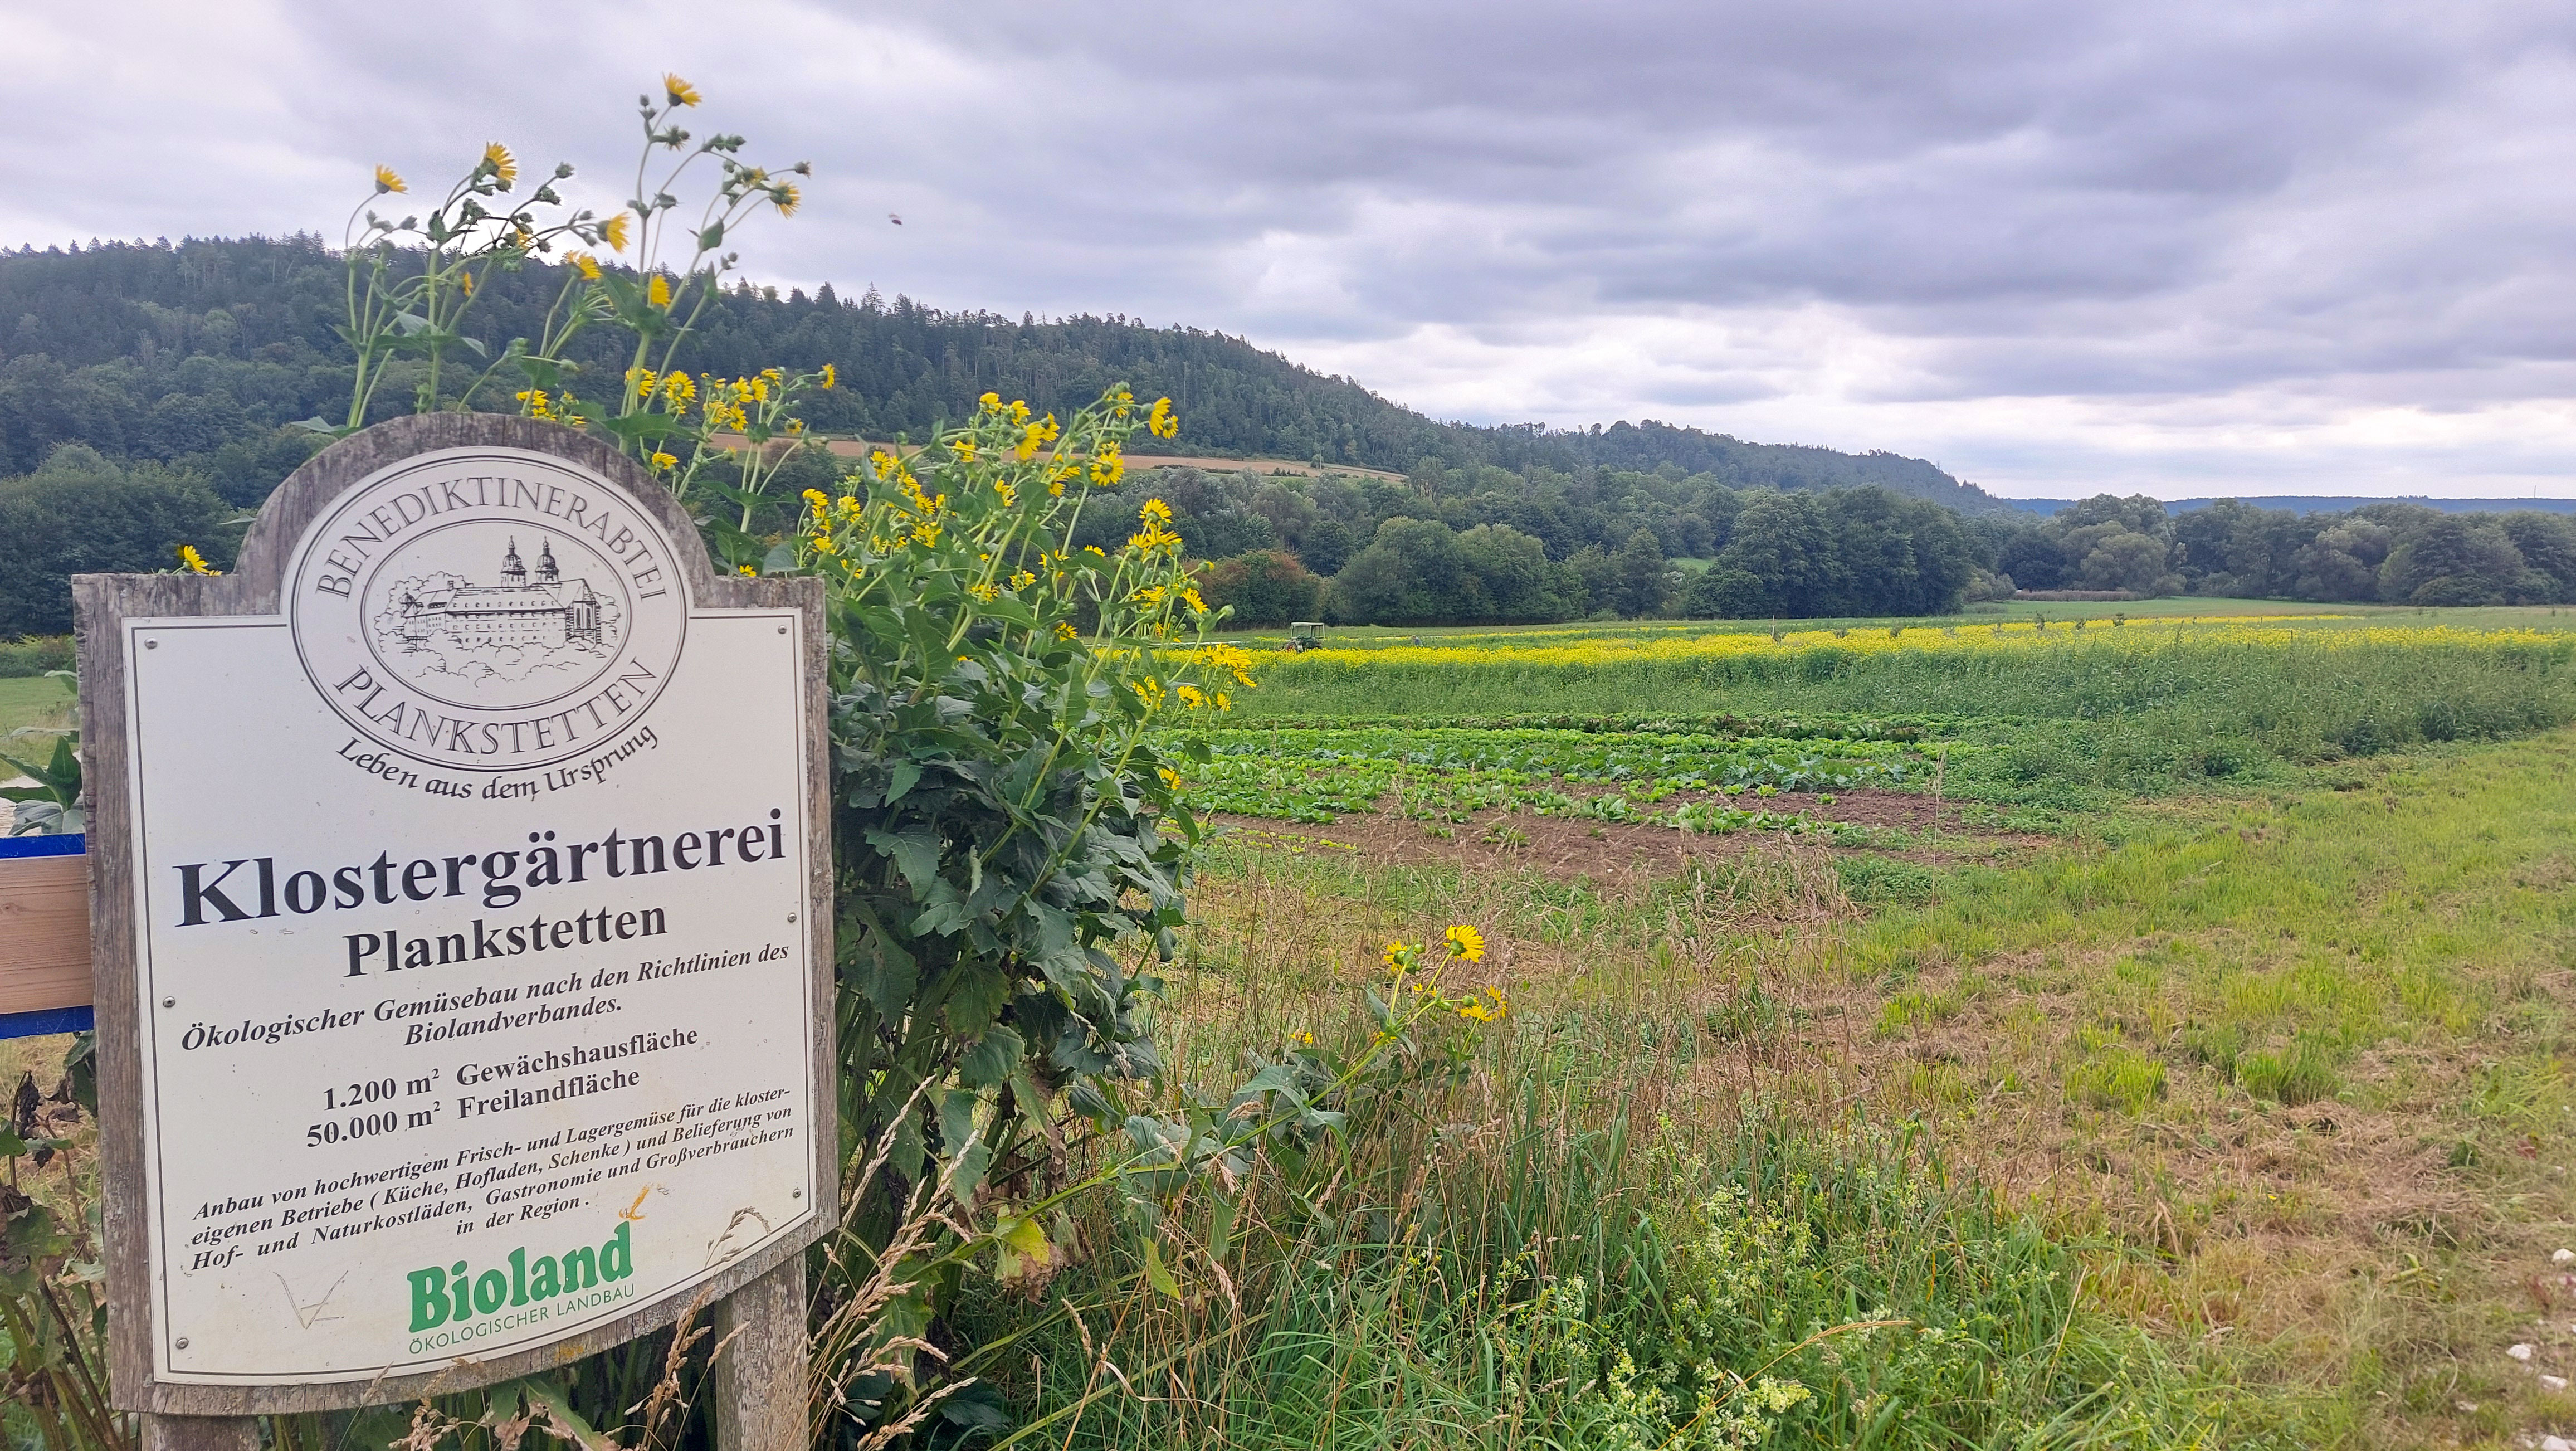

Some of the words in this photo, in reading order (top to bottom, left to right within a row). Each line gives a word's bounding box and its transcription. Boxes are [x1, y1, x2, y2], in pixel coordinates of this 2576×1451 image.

[315, 477, 666, 602] BENEDIKTINERABTEI
[334, 658, 657, 754] PLANKSTETTEN
[336, 737, 418, 789] Leben
[426, 778, 472, 798] aus
[546, 726, 658, 792] Ursprung
[173, 809, 786, 927] Klostergärtnerei
[343, 904, 668, 977] Plankstetten
[182, 1009, 364, 1050] Ökologischer
[374, 986, 517, 1021] Gemüsebau
[526, 972, 582, 999] nach
[590, 968, 629, 989] den
[637, 952, 751, 982] Richtlinien
[758, 943, 788, 961] des
[404, 997, 621, 1045] Biolandverbandes.
[306, 1111, 397, 1147] 50.000
[457, 1069, 640, 1118] Freilandfläche
[323, 1078, 396, 1110] 1.200
[457, 1028, 697, 1085] Gewächshausfläche
[191, 1218, 273, 1245] eigenen
[280, 1197, 363, 1228] Betriebe
[455, 1161, 542, 1190] Hofladen,
[637, 1130, 667, 1151] und
[673, 1115, 761, 1142] Belieferung
[767, 1106, 792, 1120] von
[191, 1244, 243, 1270] Hof-
[257, 1232, 298, 1256] und
[311, 1200, 472, 1244] Naturkostläden,
[486, 1170, 601, 1205] Gastronomie
[608, 1160, 640, 1177] und
[646, 1126, 793, 1170] Großverbrauchern
[192, 1192, 264, 1220] Anbau
[272, 1186, 306, 1204] von
[315, 1158, 448, 1194] hochwertigem
[456, 1145, 521, 1166] Frisch-
[527, 1131, 559, 1152] und
[565, 1112, 675, 1144] Lagergemüse
[678, 1105, 704, 1124] für
[709, 1098, 731, 1112] die
[735, 1088, 790, 1108] kloster-
[457, 1220, 474, 1235] in
[486, 1209, 514, 1228] der
[407, 1220, 633, 1333] Bioland
[409, 1307, 549, 1354] ÖKOLOGISCHER
[558, 1284, 634, 1316] LANDBAU
